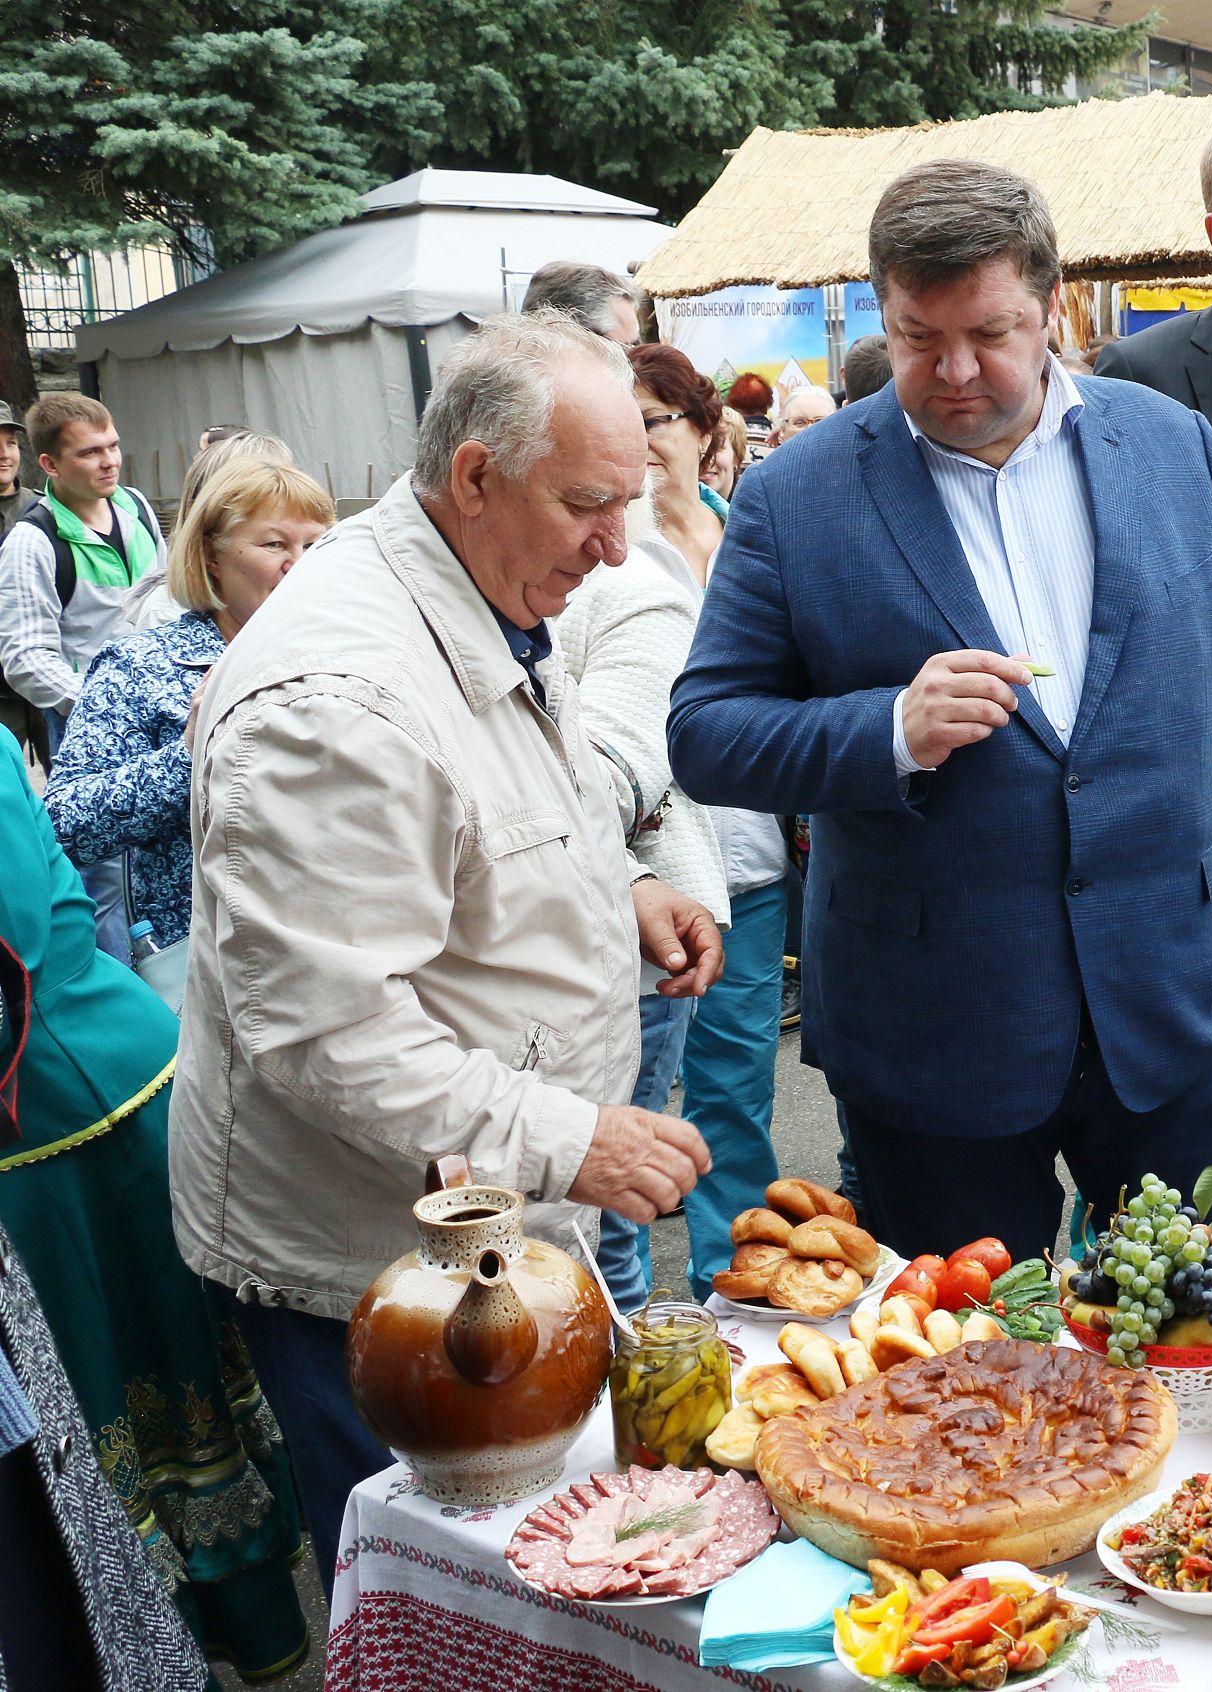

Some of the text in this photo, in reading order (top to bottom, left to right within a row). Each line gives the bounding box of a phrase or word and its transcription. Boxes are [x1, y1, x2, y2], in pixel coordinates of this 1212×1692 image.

[670, 299, 815, 317] ИЗОБИЛЬНЕНСКИЙ ГОРОДСКОЙ ОКРУГ
